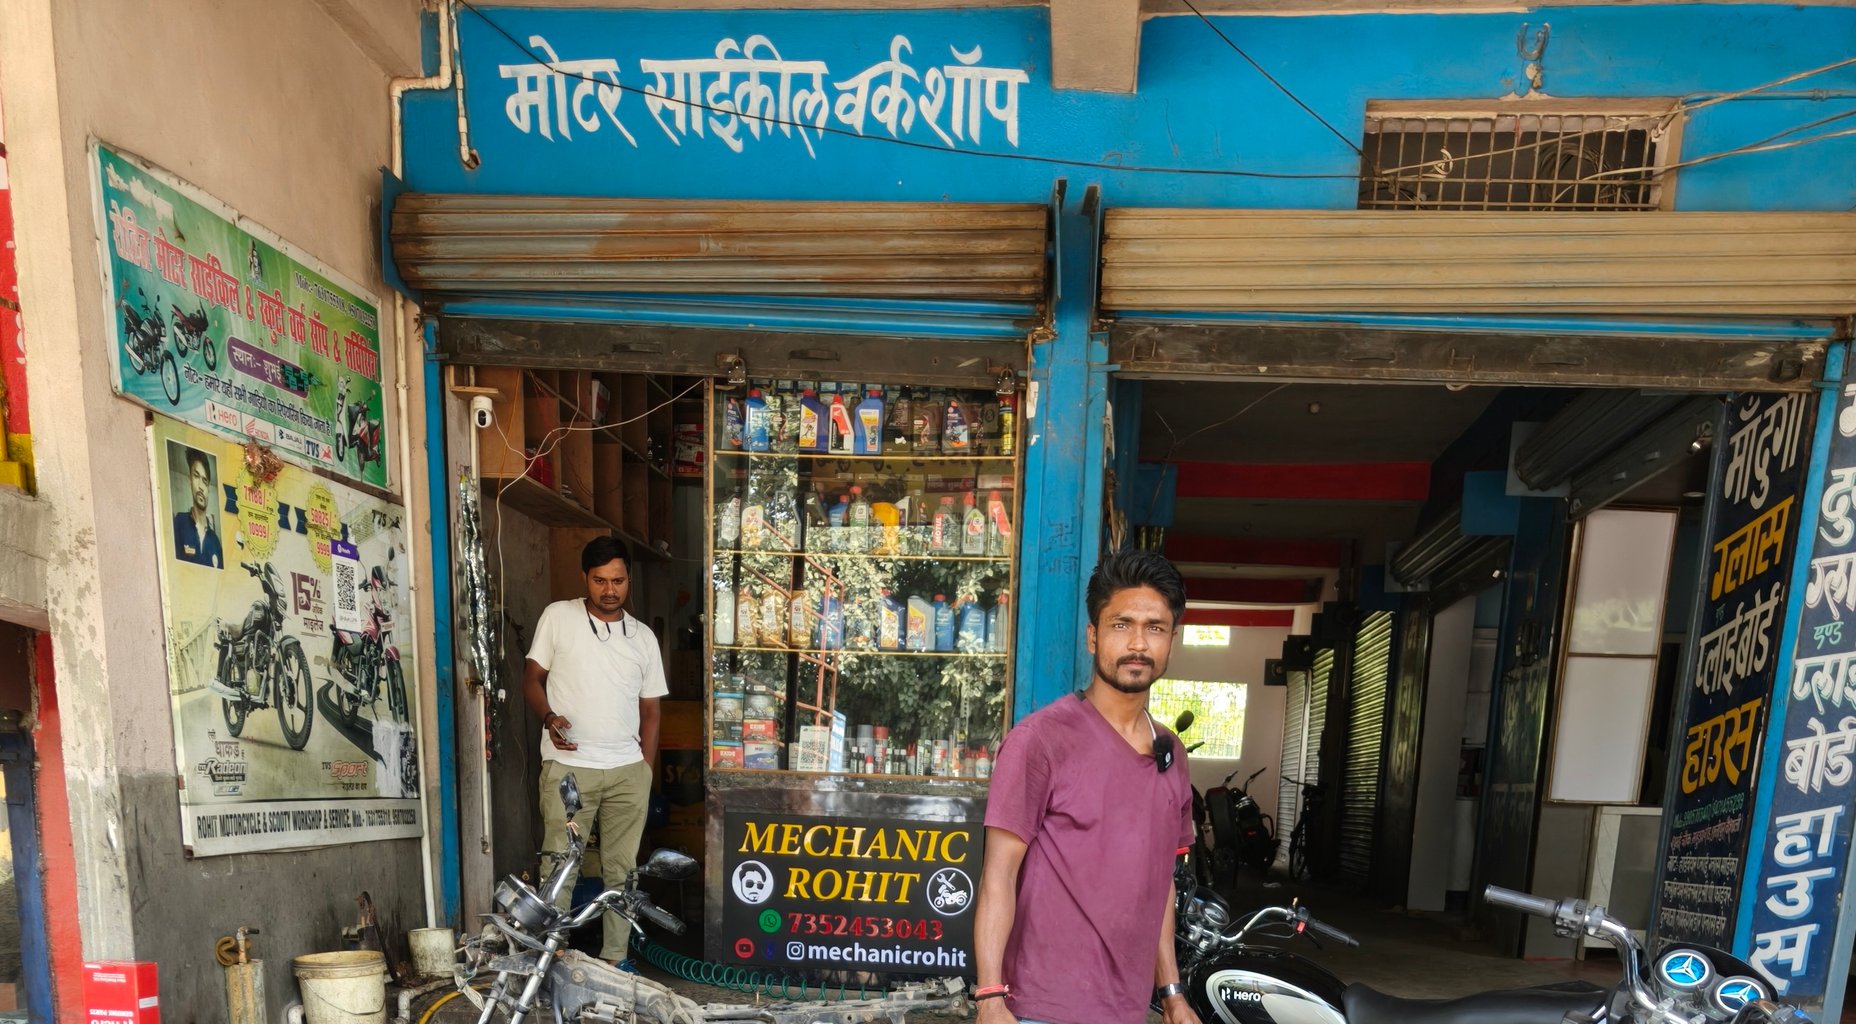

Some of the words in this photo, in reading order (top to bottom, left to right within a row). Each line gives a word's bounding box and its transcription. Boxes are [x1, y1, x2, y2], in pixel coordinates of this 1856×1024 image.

[499, 35, 637, 147] मोटर
[833, 34, 1030, 148] वर्कशॉप
[245, 285, 255, 322] &
[333, 330, 341, 362] &
[218, 409, 237, 427] Hero
[306, 440, 320, 458] TVS
[1711, 495, 1795, 601] ग्लास
[1681, 697, 1763, 795] हाउस
[204, 757, 247, 775] Radeon
[331, 760, 369, 780] Sport
[196, 815, 218, 839] ROHIT
[219, 812, 261, 838] MOTORCYCLE
[263, 812, 268, 833] &
[269, 810, 291, 832] SCOOTY
[292, 809, 322, 831] WORKSHOP
[738, 822, 969, 863] MECHANIC
[784, 868, 920, 903] ROHIT
[787, 912, 943, 941] 7352453043
[808, 942, 967, 968] mechanicrohit
[1233, 991, 1262, 1002] Hero
